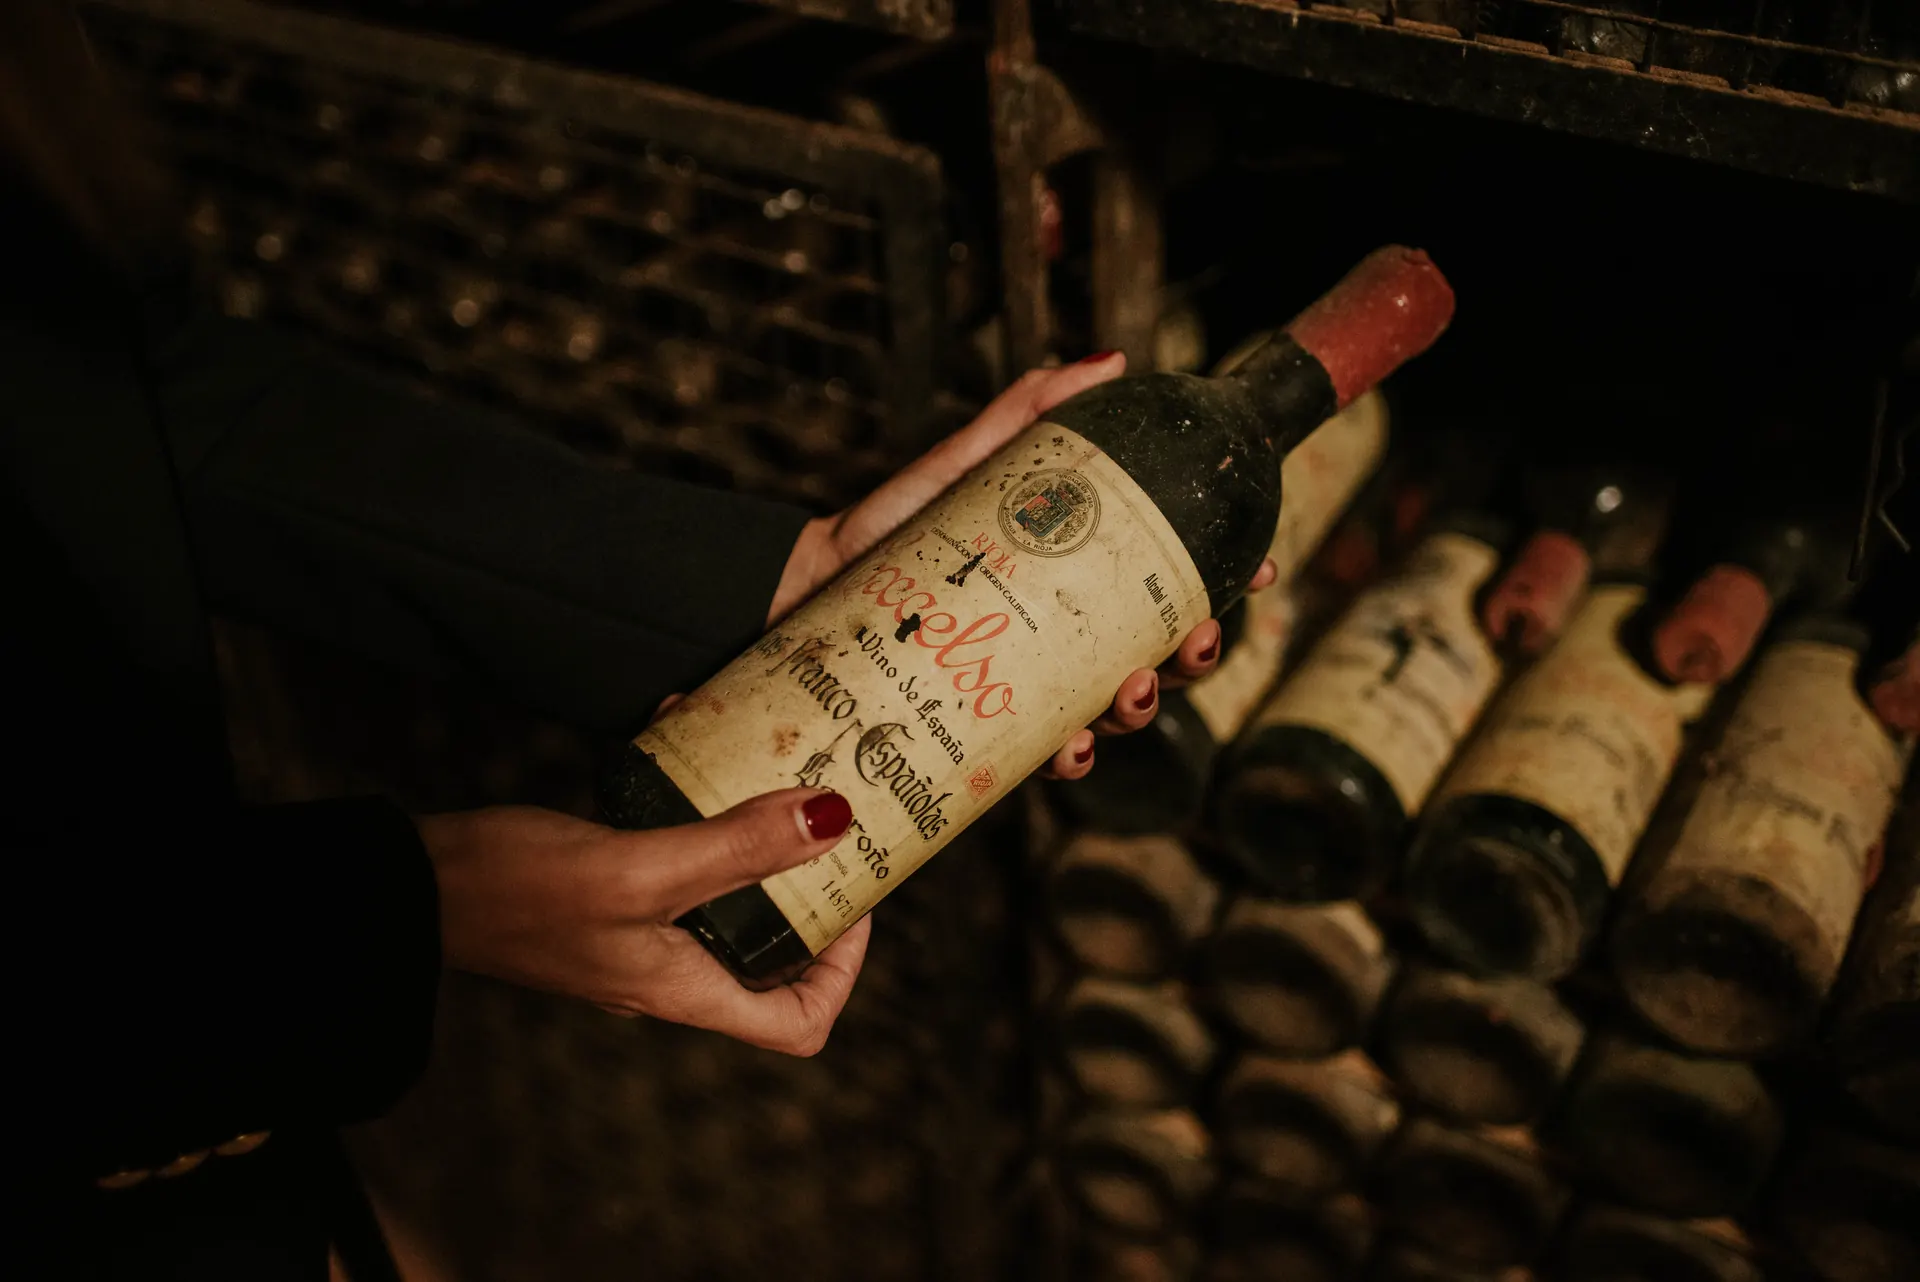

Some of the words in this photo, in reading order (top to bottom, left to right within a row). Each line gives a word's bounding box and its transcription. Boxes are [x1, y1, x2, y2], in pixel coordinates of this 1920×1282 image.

[1081, 486, 1088, 494] EN
[970, 531, 1016, 580] RIOJA
[1034, 544, 1053, 552] RIOJA
[978, 565, 1005, 591] ORIGEN
[1001, 589, 1038, 633] CALIFICADA
[1142, 572, 1168, 605] Alcohol
[861, 634, 897, 677] Vino
[899, 676, 918, 703] de
[918, 702, 966, 766] España
[828, 851, 848, 878] ESPAÑA
[820, 879, 854, 919] 14873
